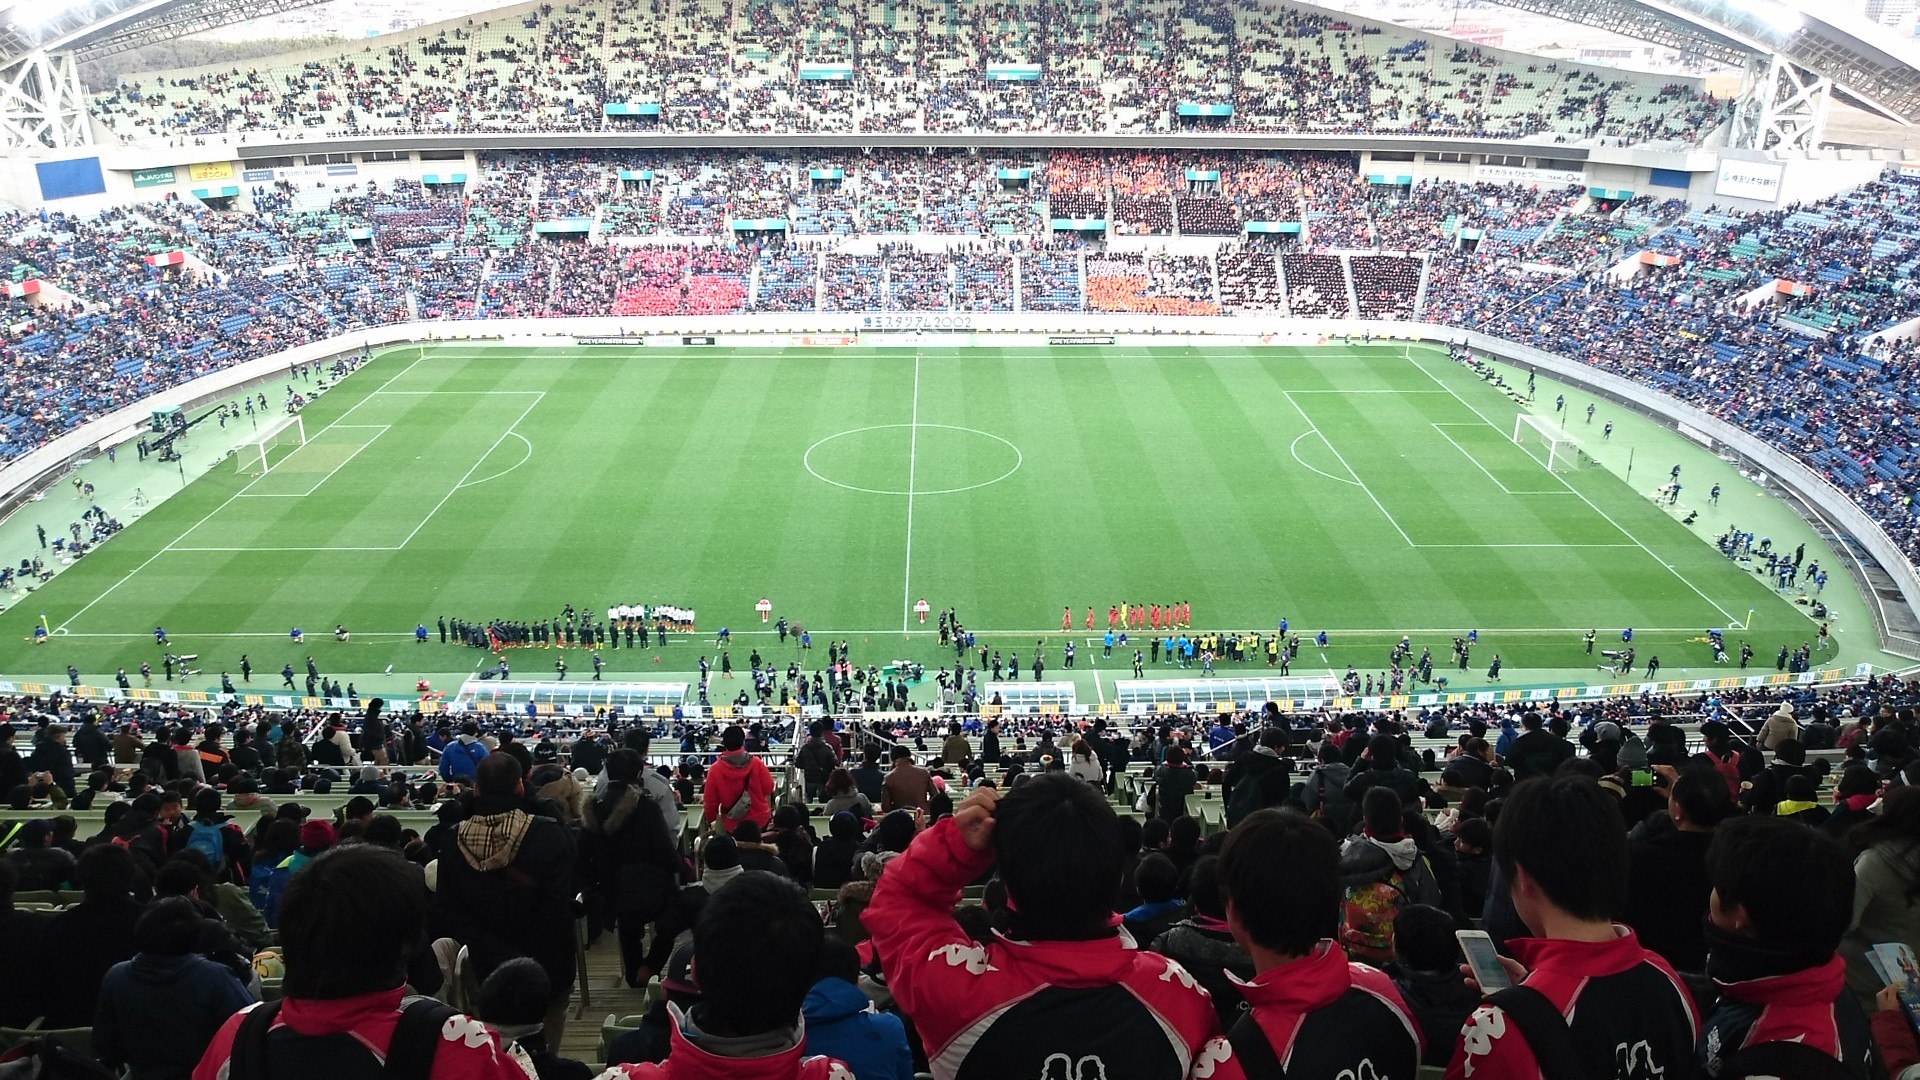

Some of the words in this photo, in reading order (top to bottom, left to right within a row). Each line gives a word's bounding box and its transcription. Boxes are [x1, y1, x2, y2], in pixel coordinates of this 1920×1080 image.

[1732, 174, 1777, 187] 埼玉りそな銀行
[863, 316, 972, 328] 埼玉スタジアム2002
